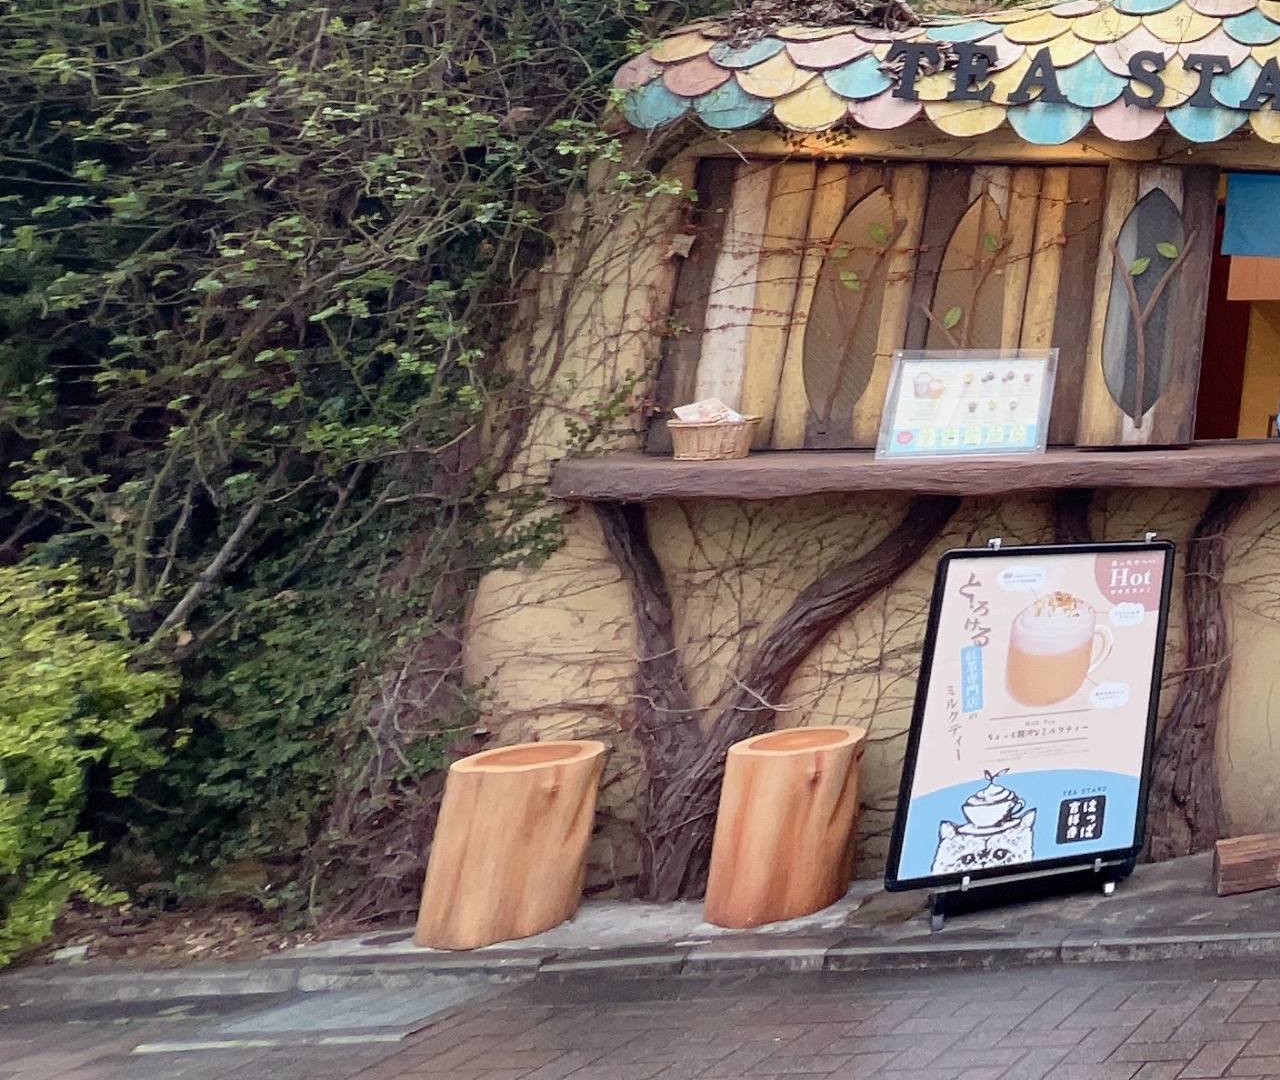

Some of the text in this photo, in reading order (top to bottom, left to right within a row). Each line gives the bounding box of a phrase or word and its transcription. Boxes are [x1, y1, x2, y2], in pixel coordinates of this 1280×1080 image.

[884, 39, 1067, 104] TEA
[959, 573, 991, 648] とろける
[1109, 568, 1151, 587] Hot
[946, 685, 963, 761] ミルクティー
